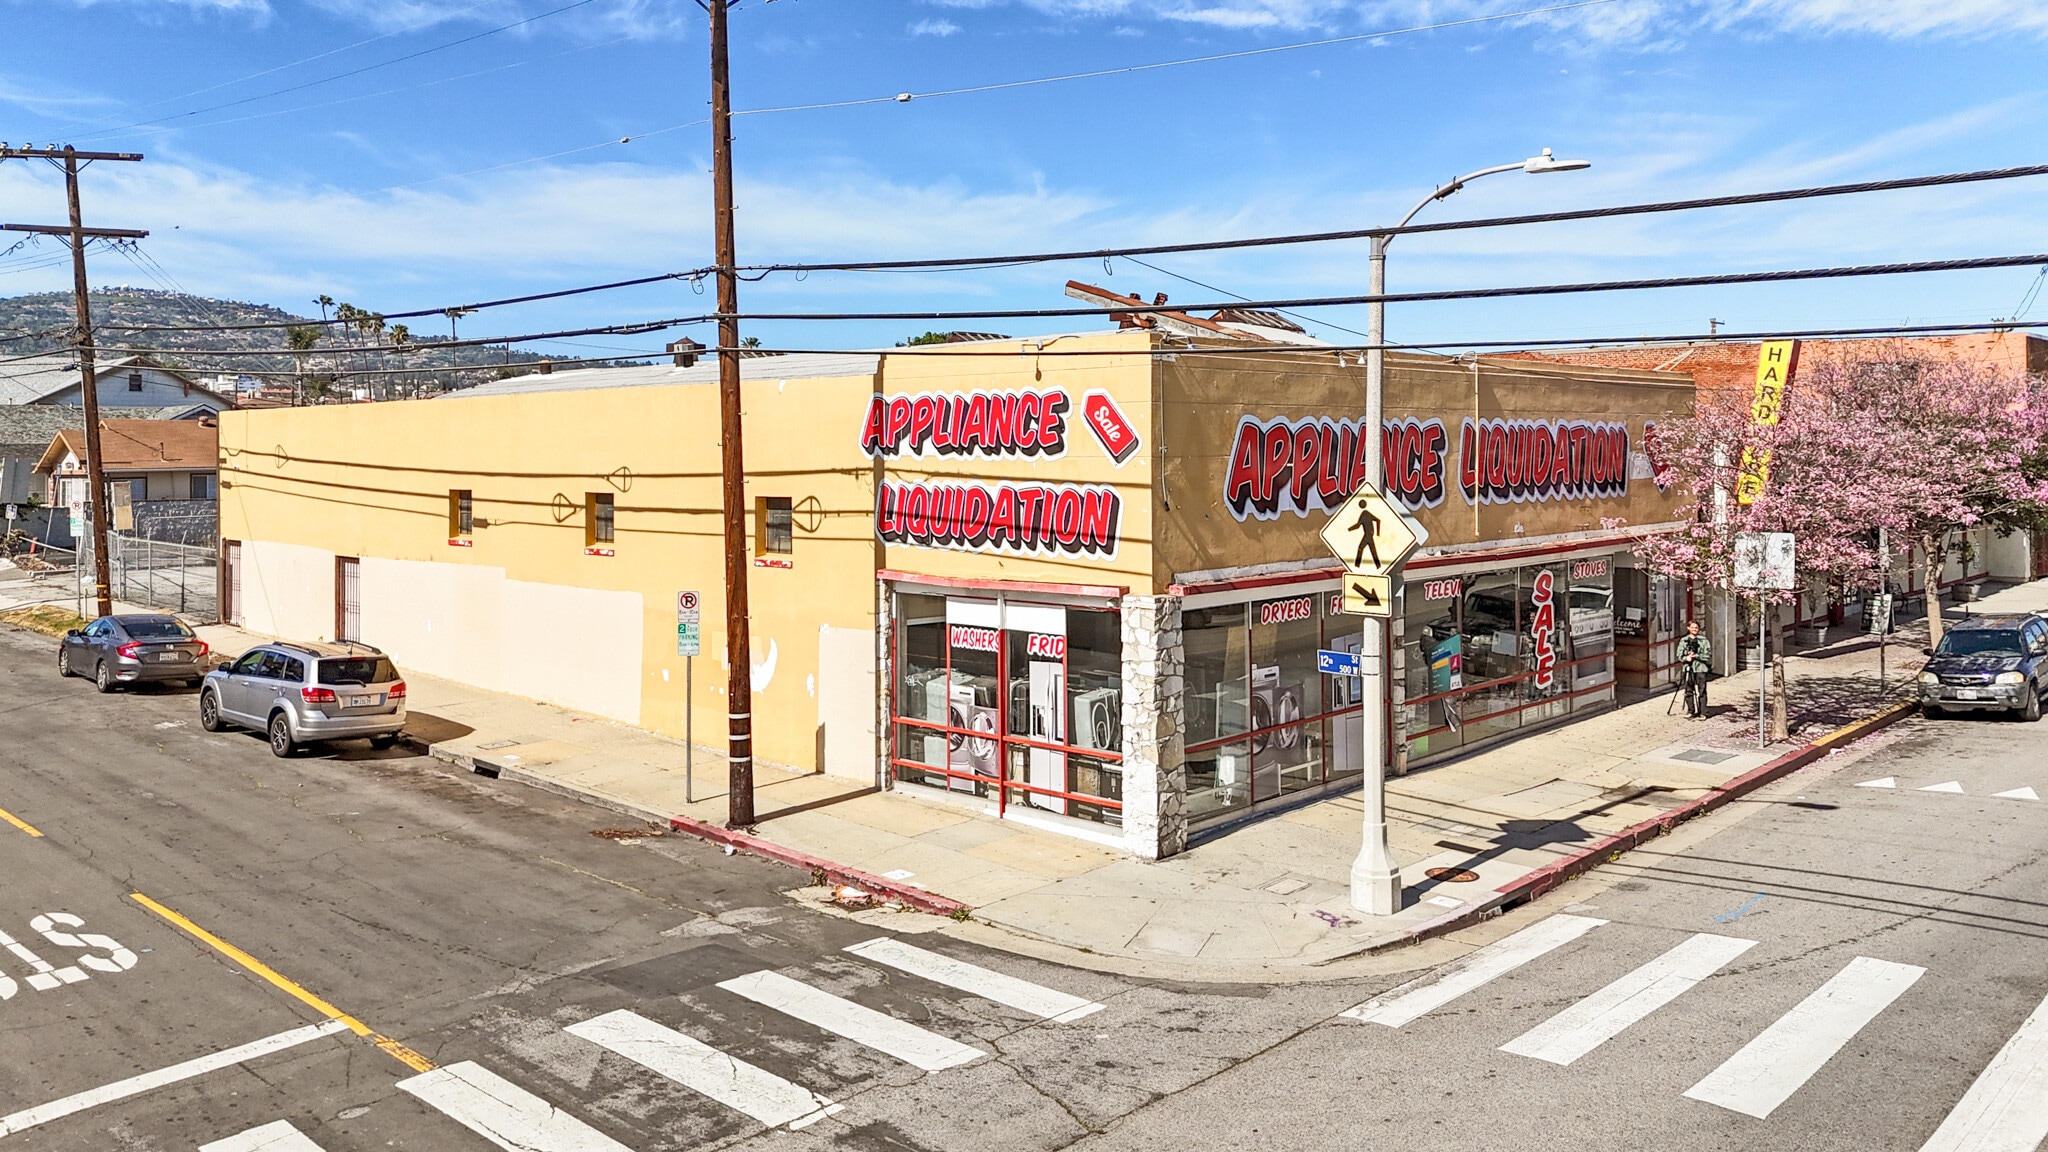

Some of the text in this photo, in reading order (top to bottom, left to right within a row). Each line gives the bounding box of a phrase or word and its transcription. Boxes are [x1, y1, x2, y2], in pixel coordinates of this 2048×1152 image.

[861, 390, 1069, 455] APPLIANCE
[1093, 405, 1121, 443] Sale
[1461, 423, 1627, 494] LIQUIDATION
[877, 484, 1119, 553] LIQUIDATION
[1573, 560, 1606, 578] STOVES
[1262, 599, 1311, 624] DRYERS
[679, 624, 685, 633] 2
[952, 627, 999, 650] WASHERS
[1533, 573, 1555, 685] SALE
[1028, 635, 1064, 656] FRID
[1351, 655, 1359, 664] St
